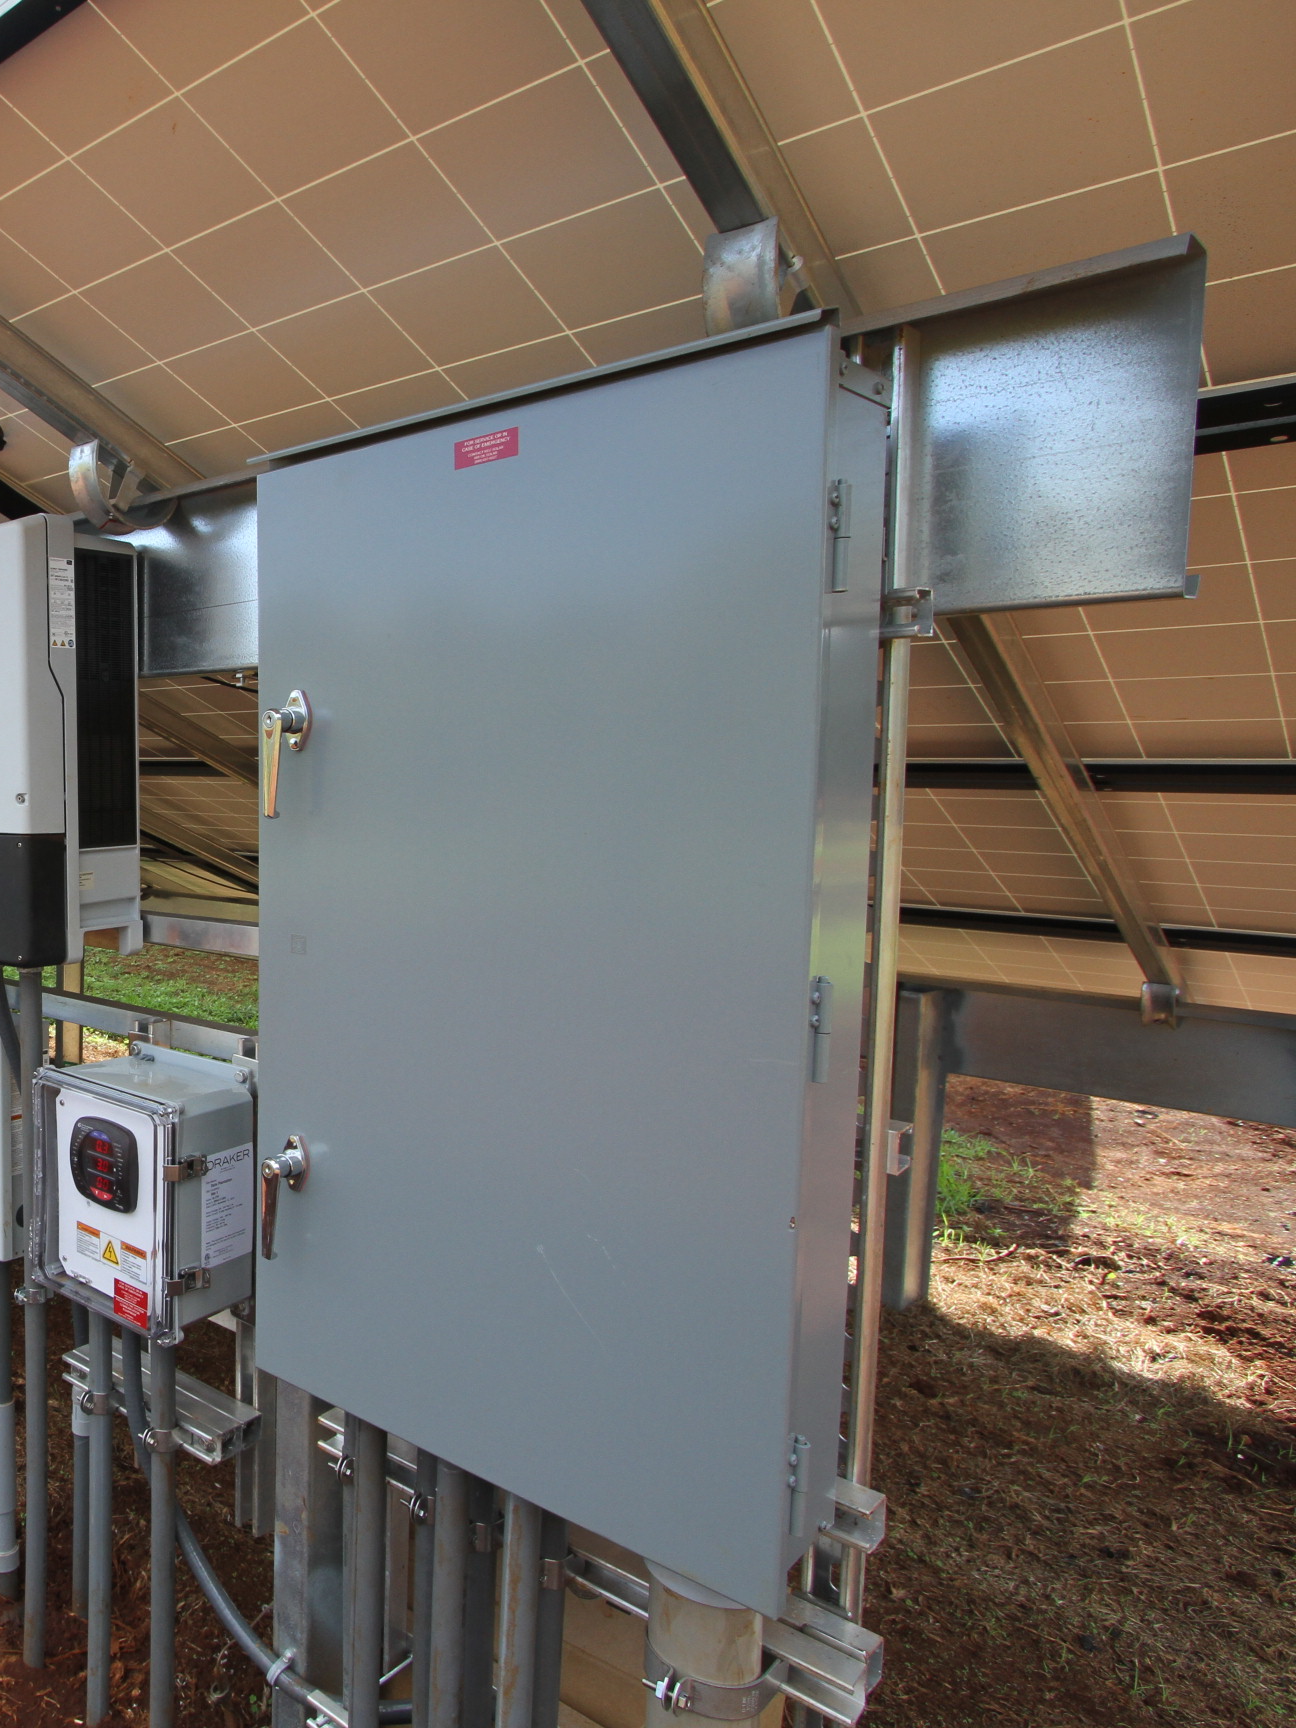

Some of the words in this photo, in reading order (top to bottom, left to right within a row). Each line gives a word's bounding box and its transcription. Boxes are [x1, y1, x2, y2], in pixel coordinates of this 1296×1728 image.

[461, 445, 474, 453] CASE
[481, 436, 511, 448] EMERGENCY
[474, 434, 494, 444] SERVICE
[206, 1148, 250, 1171] DRAKER
